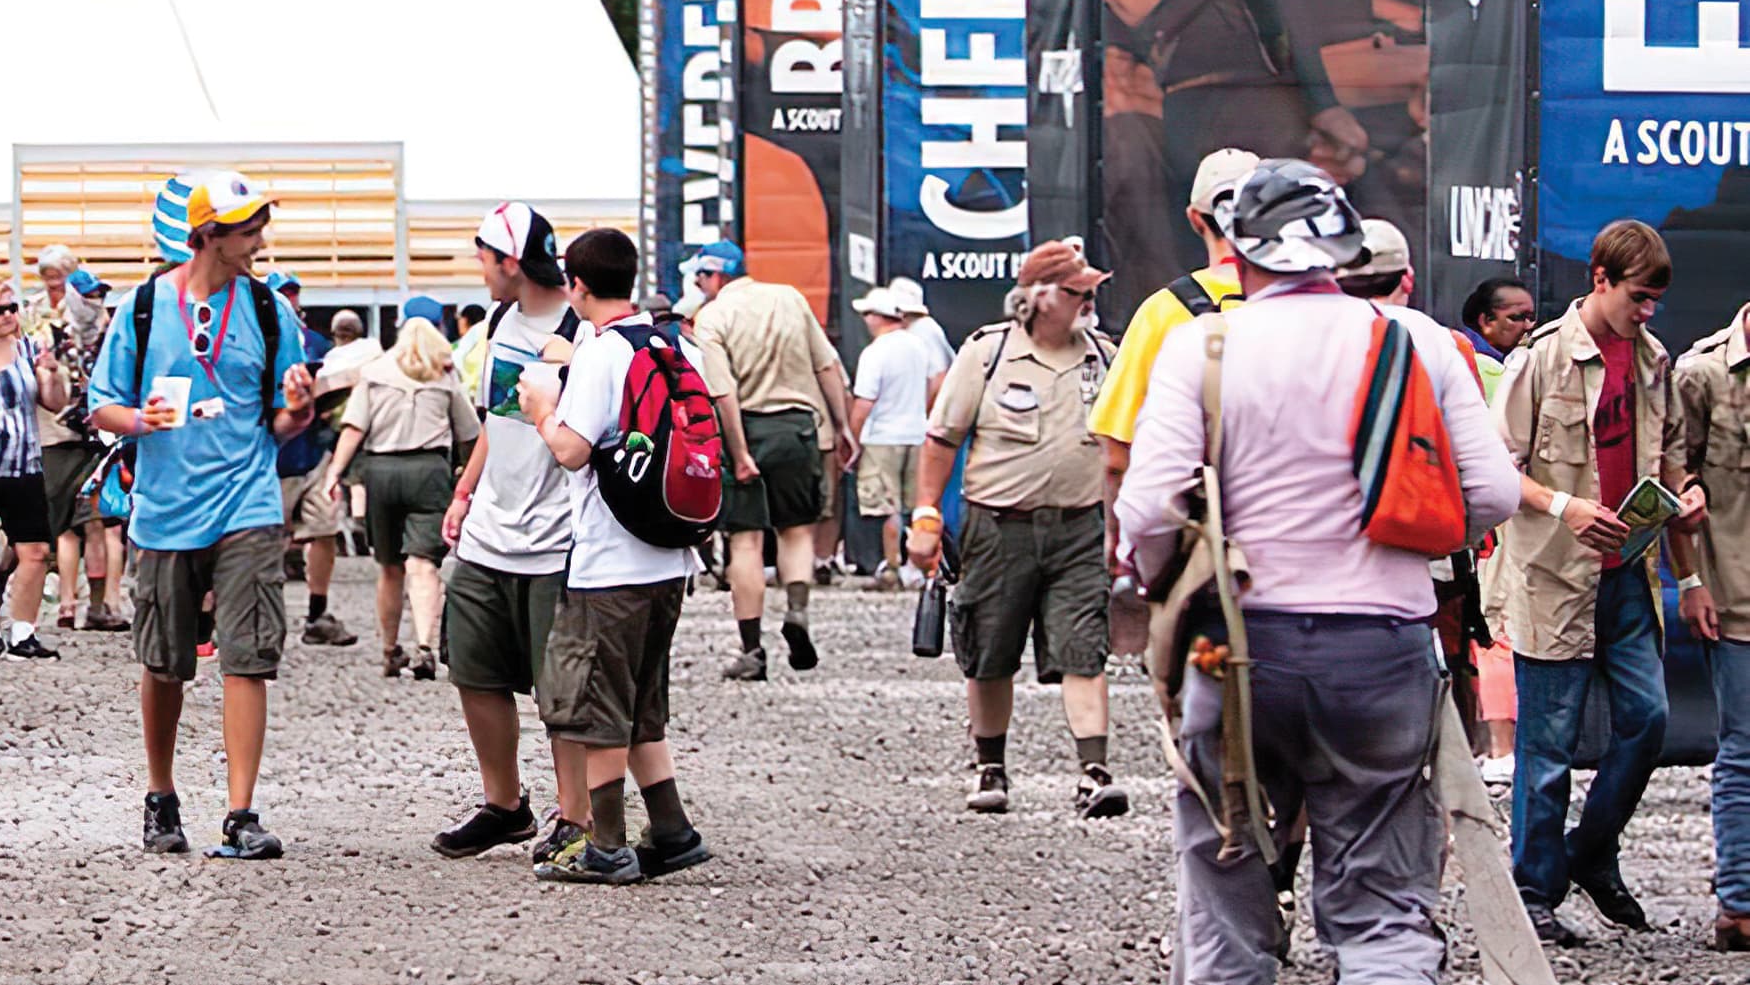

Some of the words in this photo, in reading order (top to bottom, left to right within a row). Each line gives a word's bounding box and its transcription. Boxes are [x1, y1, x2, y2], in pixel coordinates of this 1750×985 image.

[771, 109, 786, 129] A
[788, 108, 843, 130] SCOUT
[1602, 119, 1629, 164] A
[1636, 119, 1750, 166] SCOUT
[922, 252, 938, 279] A
[941, 252, 1008, 279] SCOUT
